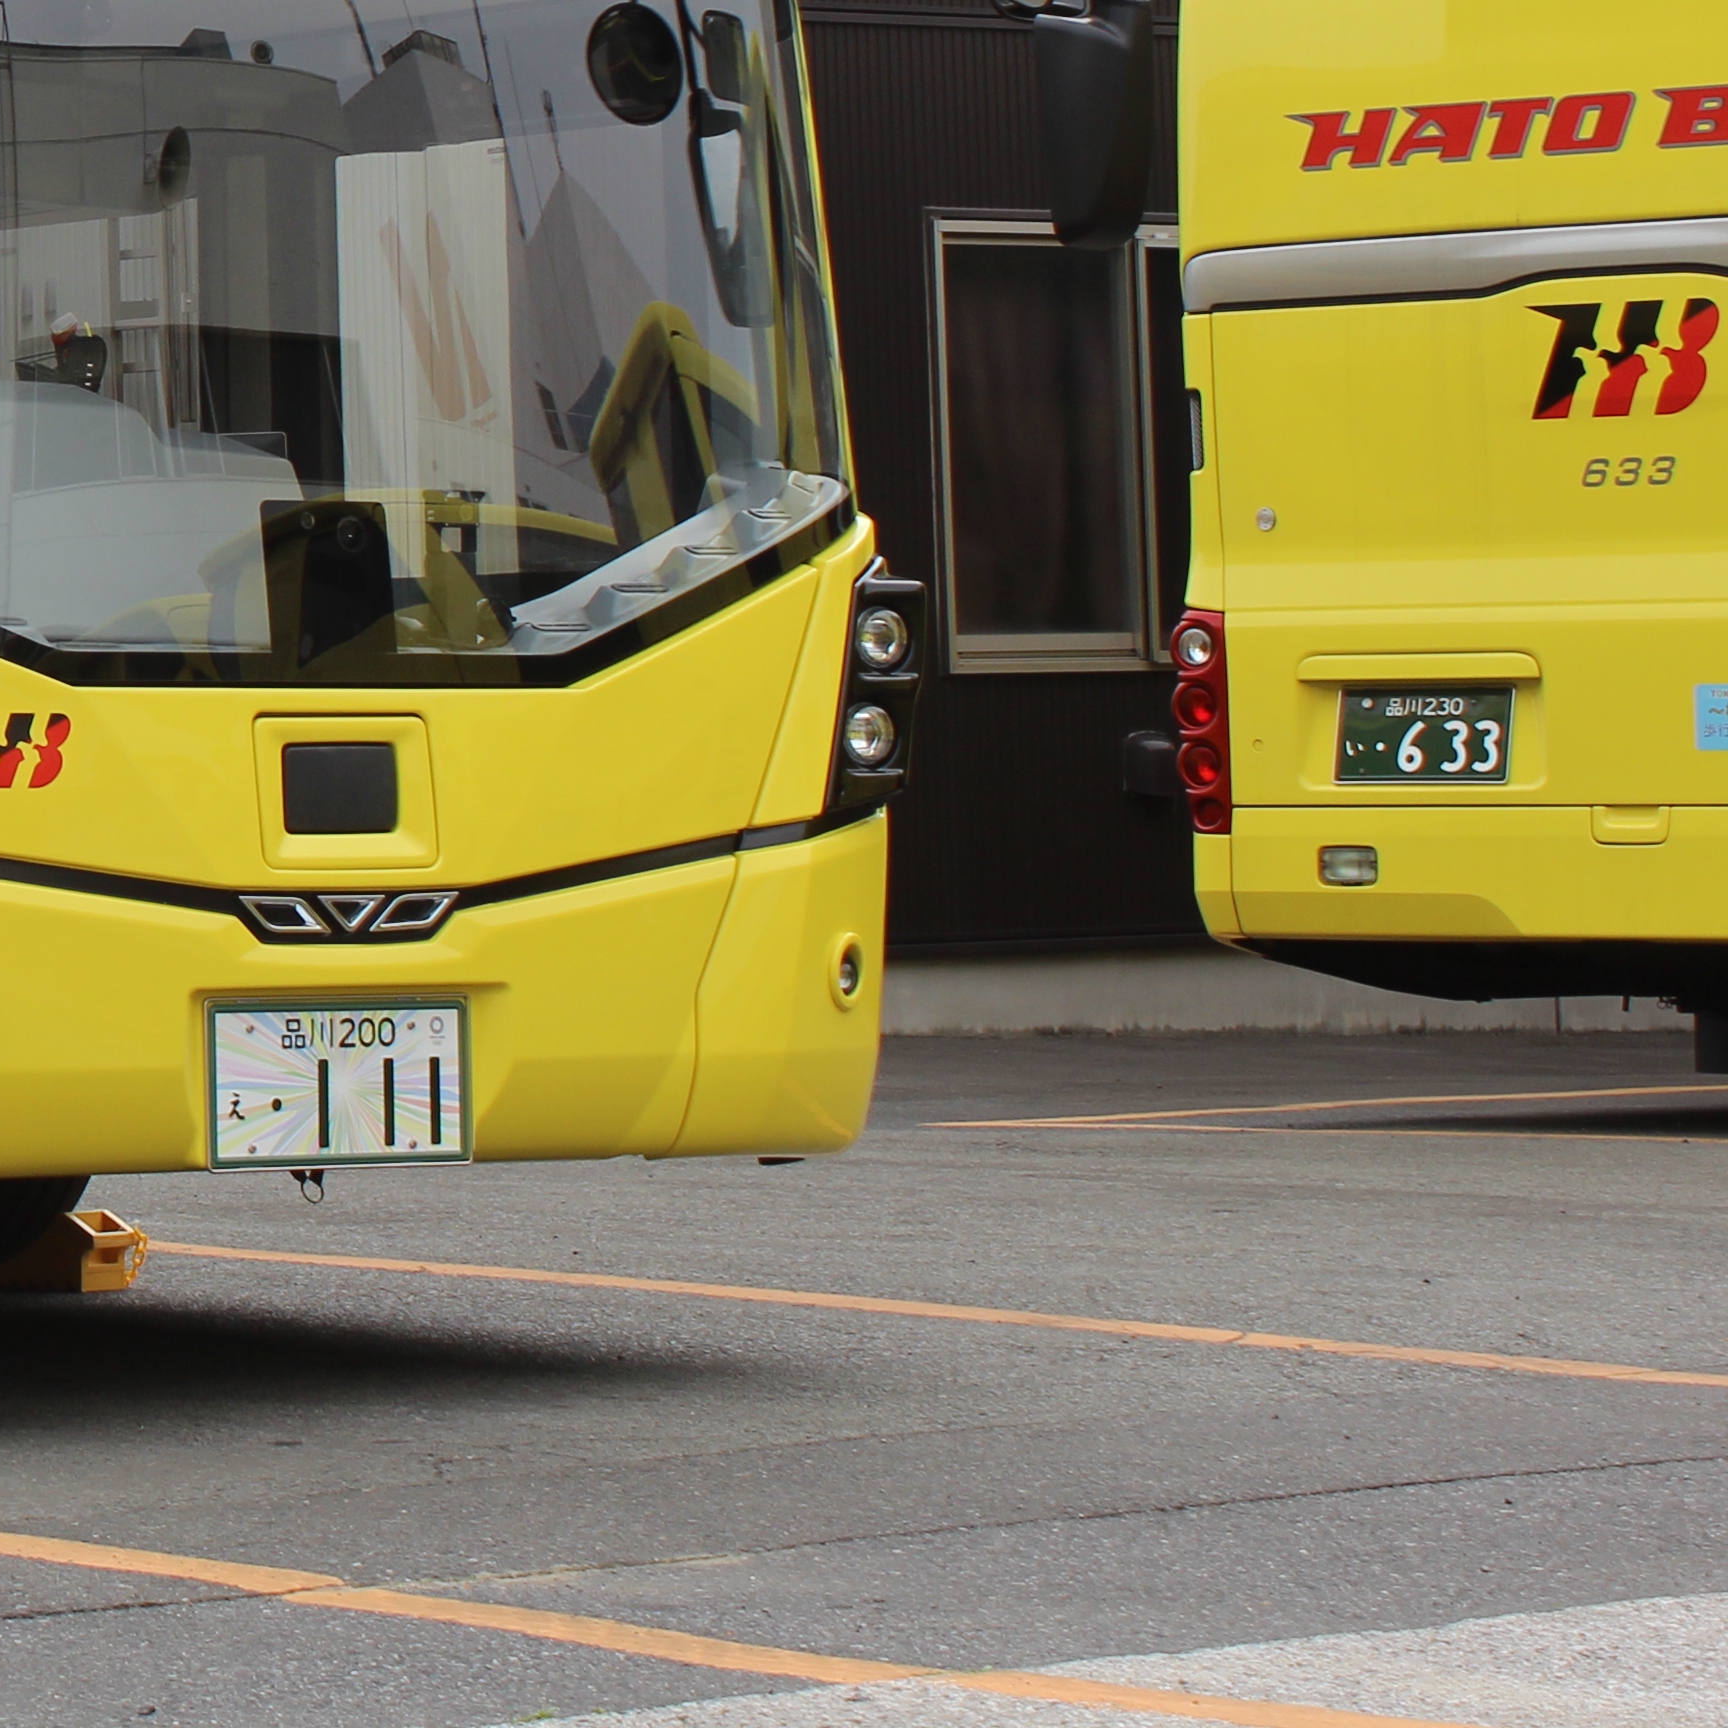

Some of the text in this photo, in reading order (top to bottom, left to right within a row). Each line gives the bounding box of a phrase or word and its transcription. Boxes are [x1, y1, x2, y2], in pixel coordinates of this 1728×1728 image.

[1285, 91, 1636, 172] HATO
[1581, 456, 1676, 487] 633
[228, 1092, 246, 1120] え
